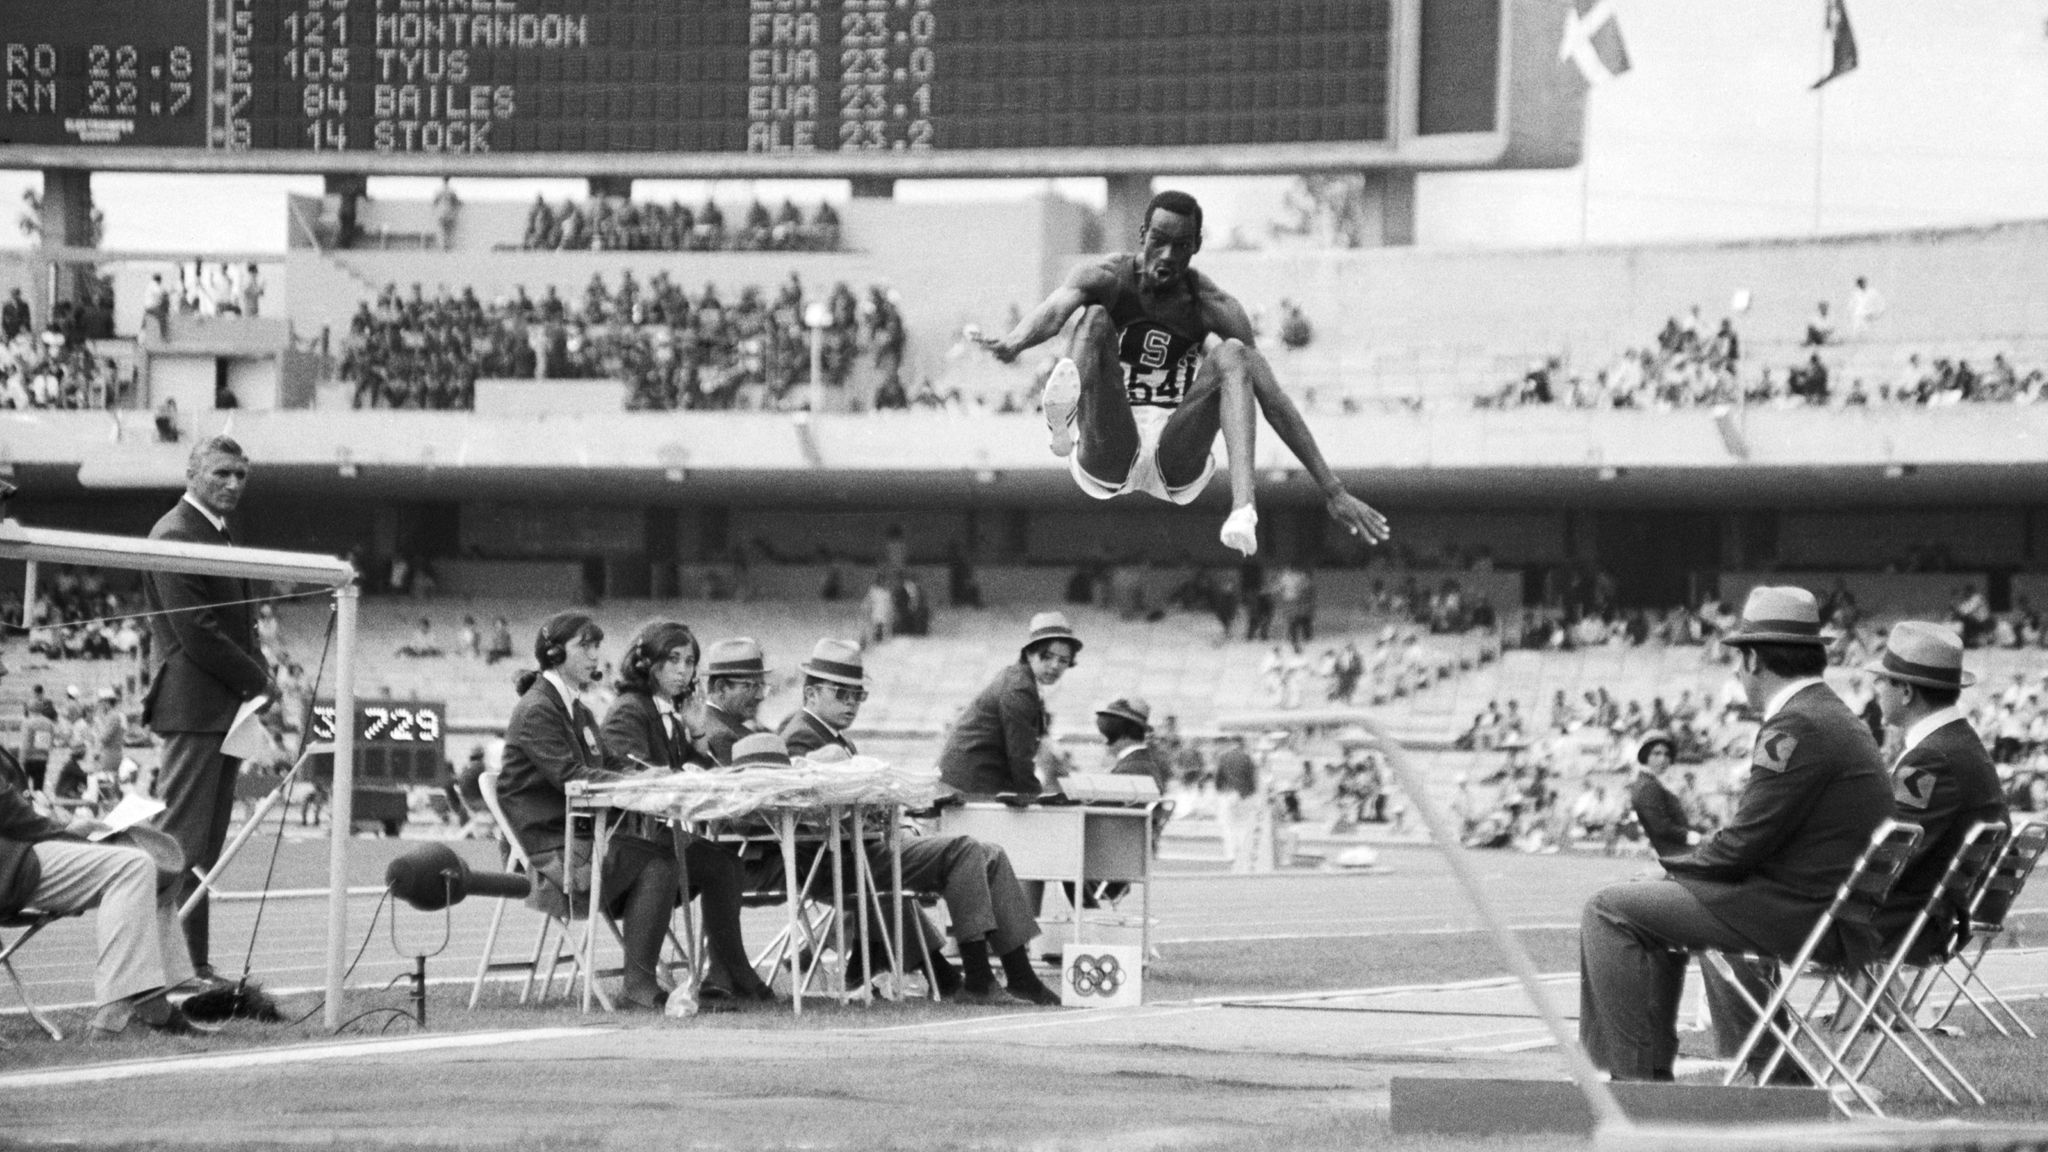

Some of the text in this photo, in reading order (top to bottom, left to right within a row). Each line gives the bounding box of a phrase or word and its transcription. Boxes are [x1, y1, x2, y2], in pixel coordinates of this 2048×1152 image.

[284, 12, 347, 46] 121
[376, 13, 588, 48] MONTANDON
[750, 13, 820, 47] FRA
[841, 11, 936, 48] 23.0
[88, 44, 192, 79] 22.8
[284, 48, 349, 82] 105
[376, 48, 470, 83] TYUS
[749, 49, 819, 84] EUA
[840, 47, 935, 84] 23.0
[7, 79, 192, 116] RM 22.7
[231, 83, 931, 120] 7 84 BAILES EUA 23.1
[307, 119, 346, 153] 14
[374, 120, 492, 154] STOCK
[747, 120, 818, 152] ALE
[838, 119, 934, 152] 23.2
[364, 706, 439, 741] 729
